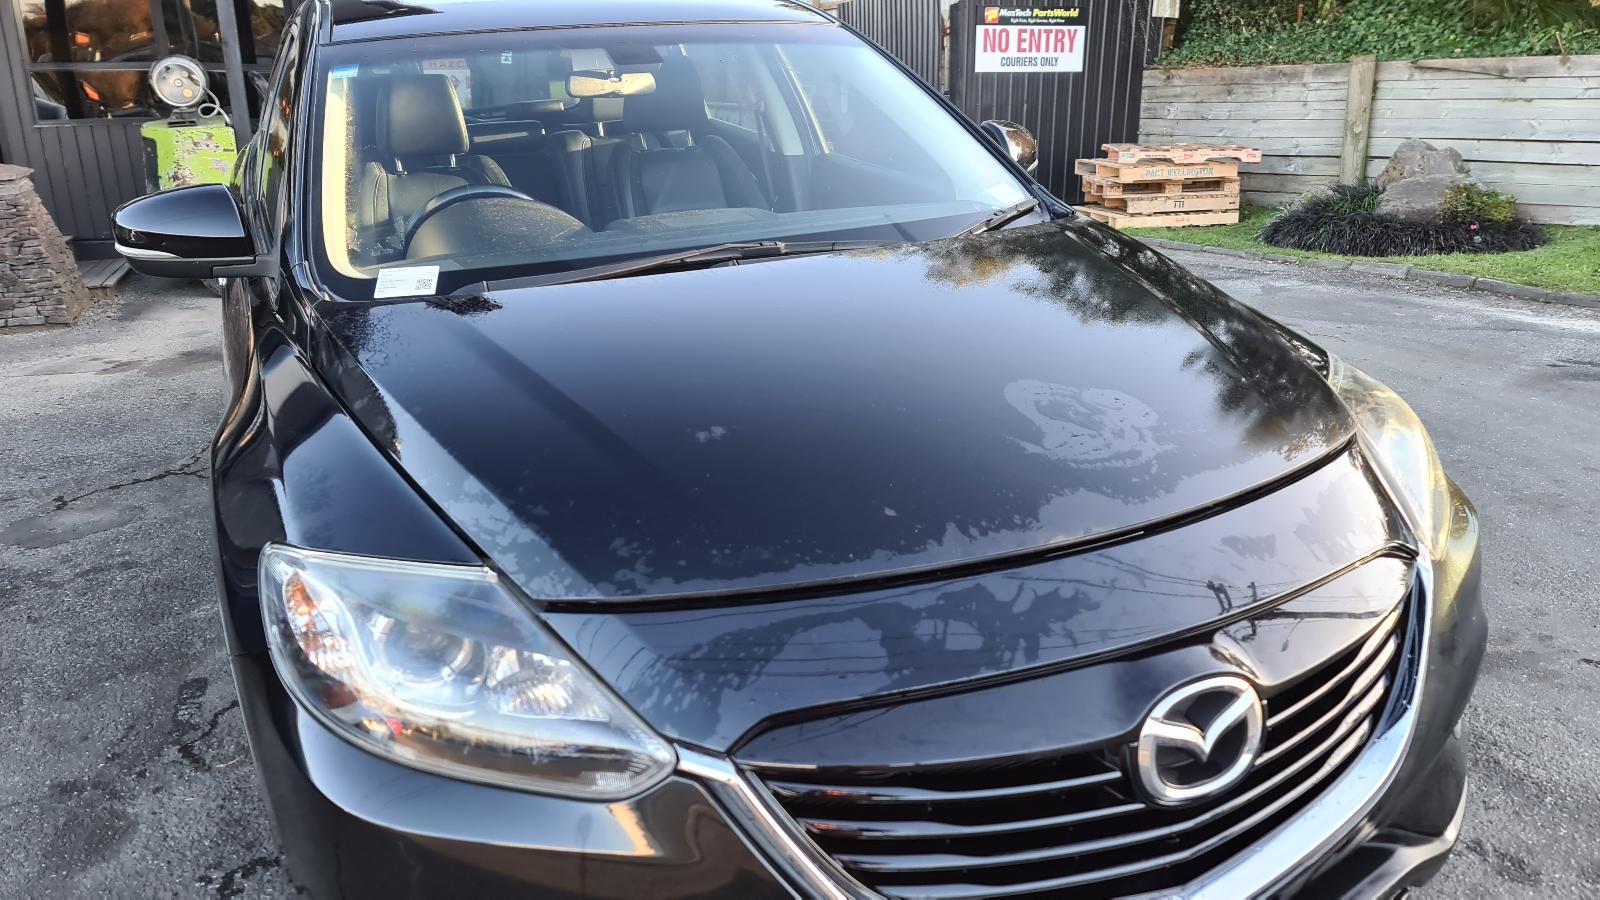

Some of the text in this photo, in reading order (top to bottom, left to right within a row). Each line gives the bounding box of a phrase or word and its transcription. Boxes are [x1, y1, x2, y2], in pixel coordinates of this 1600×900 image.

[1033, 8, 1079, 17] PartsWorld
[983, 28, 1078, 53] NO ENTRY
[1001, 57, 1059, 67] COURIERS ONLY
[1167, 167, 1214, 177] WELLINGTON
